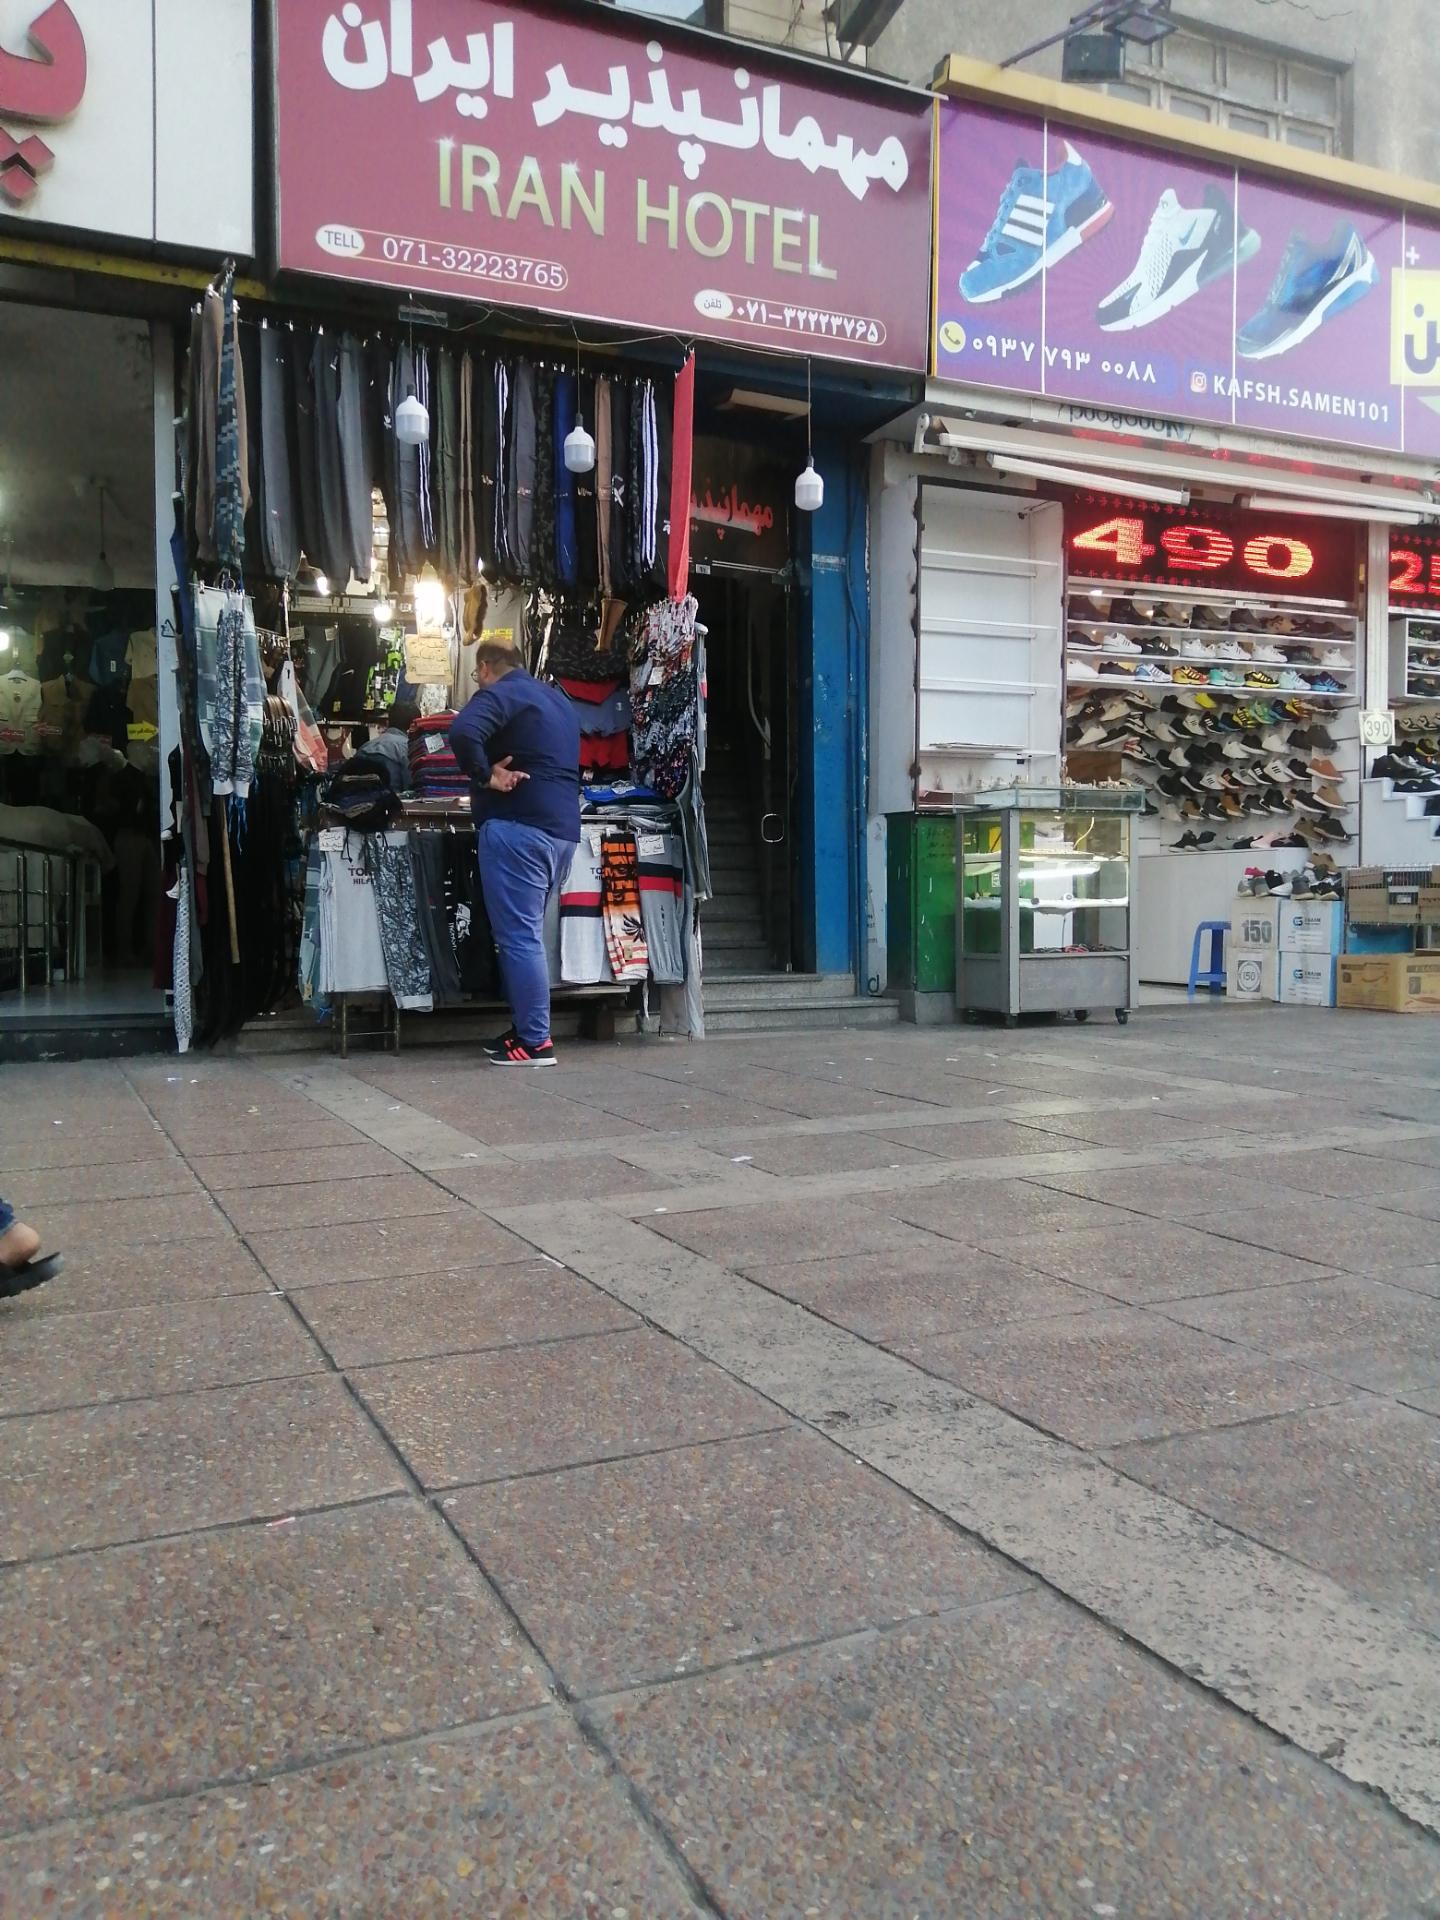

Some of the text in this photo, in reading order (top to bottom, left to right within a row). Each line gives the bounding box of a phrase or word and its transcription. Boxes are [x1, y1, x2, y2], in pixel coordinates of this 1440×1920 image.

[322, 0, 908, 200] مهمانپذیر ایران
[438, 137, 837, 280] IRAN HOTEL
[324, 230, 563, 287] TELL 071-32223765
[703, 299, 723, 310] تلفن
[1213, 375, 1389, 423] KAFSH.SAMEN101
[1072, 517, 1314, 578] 490
[1365, 720, 1390, 738] 390
[1242, 920, 1272, 943] 150
[1243, 972, 1256, 981] 150
